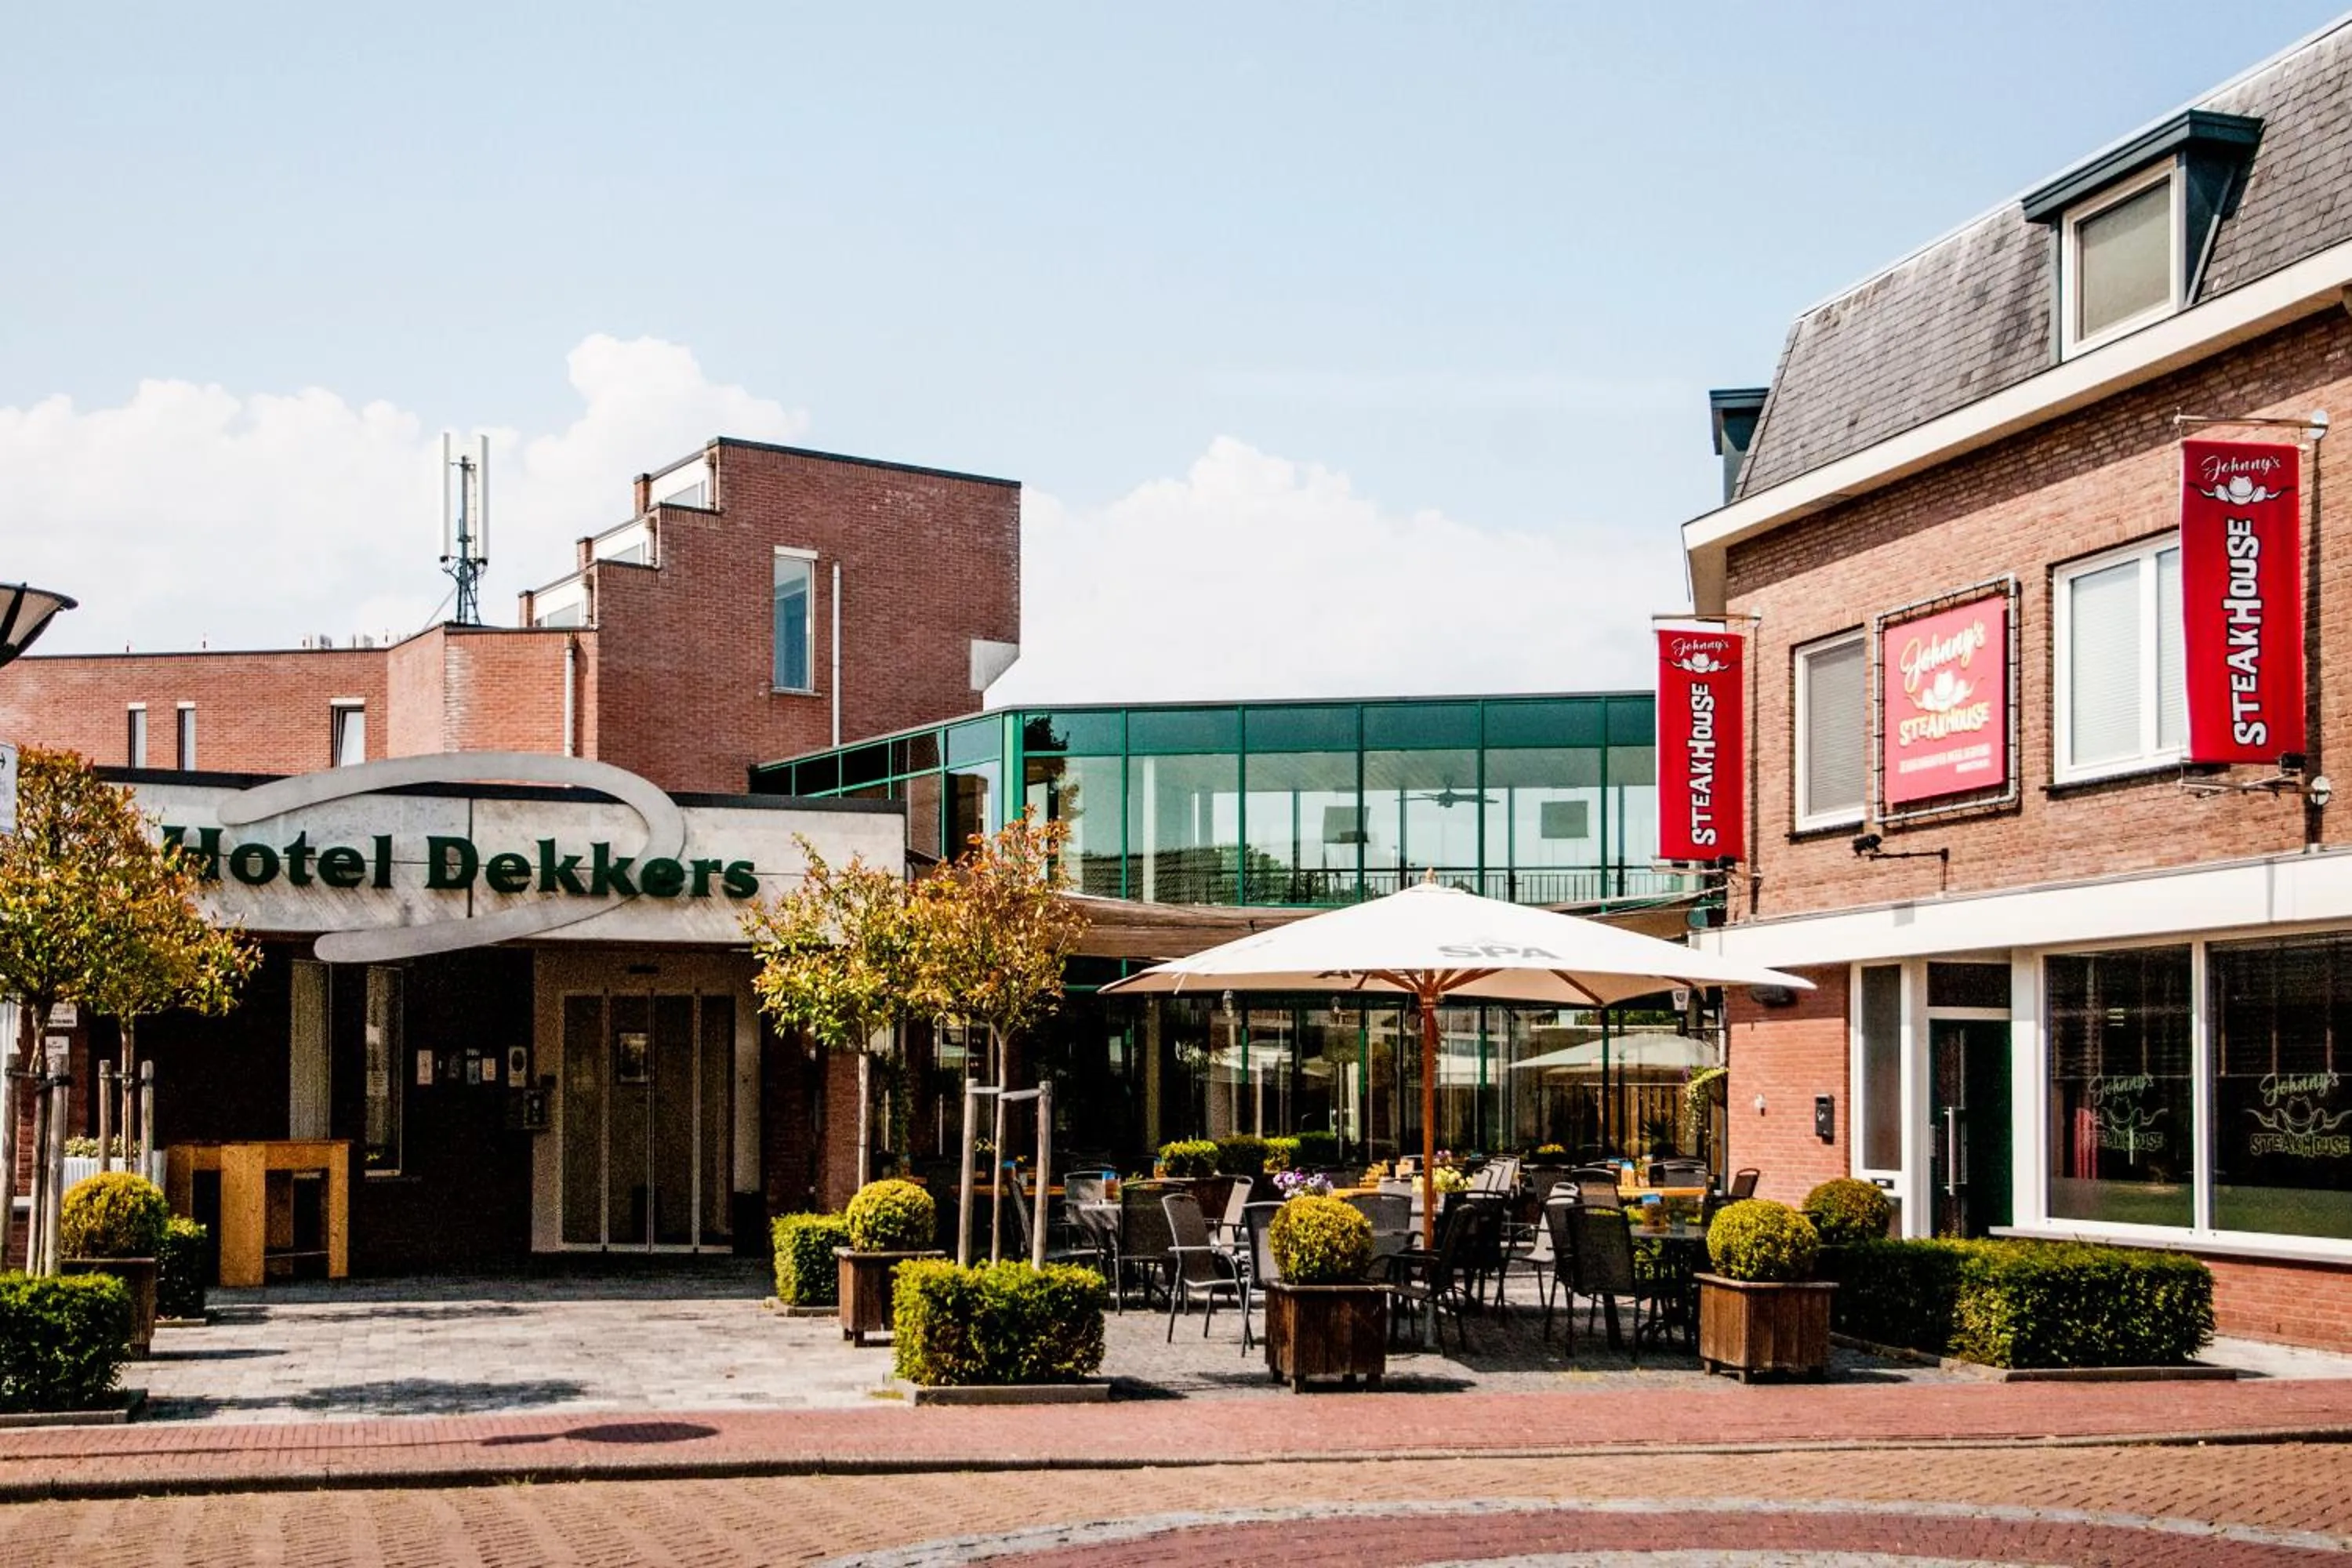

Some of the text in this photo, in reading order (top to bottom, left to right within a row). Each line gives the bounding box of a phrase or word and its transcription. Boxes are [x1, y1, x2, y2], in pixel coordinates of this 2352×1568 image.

[2201, 455, 2281, 482] Johnny's
[1671, 637, 1730, 656] Johnny's
[2222, 517, 2267, 747] STEAKHOUSE
[1900, 619, 1986, 693] Johnny's
[1899, 702, 1990, 747] STEAKHOUSE
[1687, 682, 1716, 846] STEAKHOUSE
[161, 826, 760, 898] Hotel Dekkers
[1438, 946, 1562, 960] SPA
[2088, 1072, 2154, 1105] Johnny's
[2259, 1072, 2339, 1106] Johnny's
[2082, 1130, 2164, 1152] TEAKHOUSE
[2249, 1133, 2350, 1158] STEAKHOUSE
